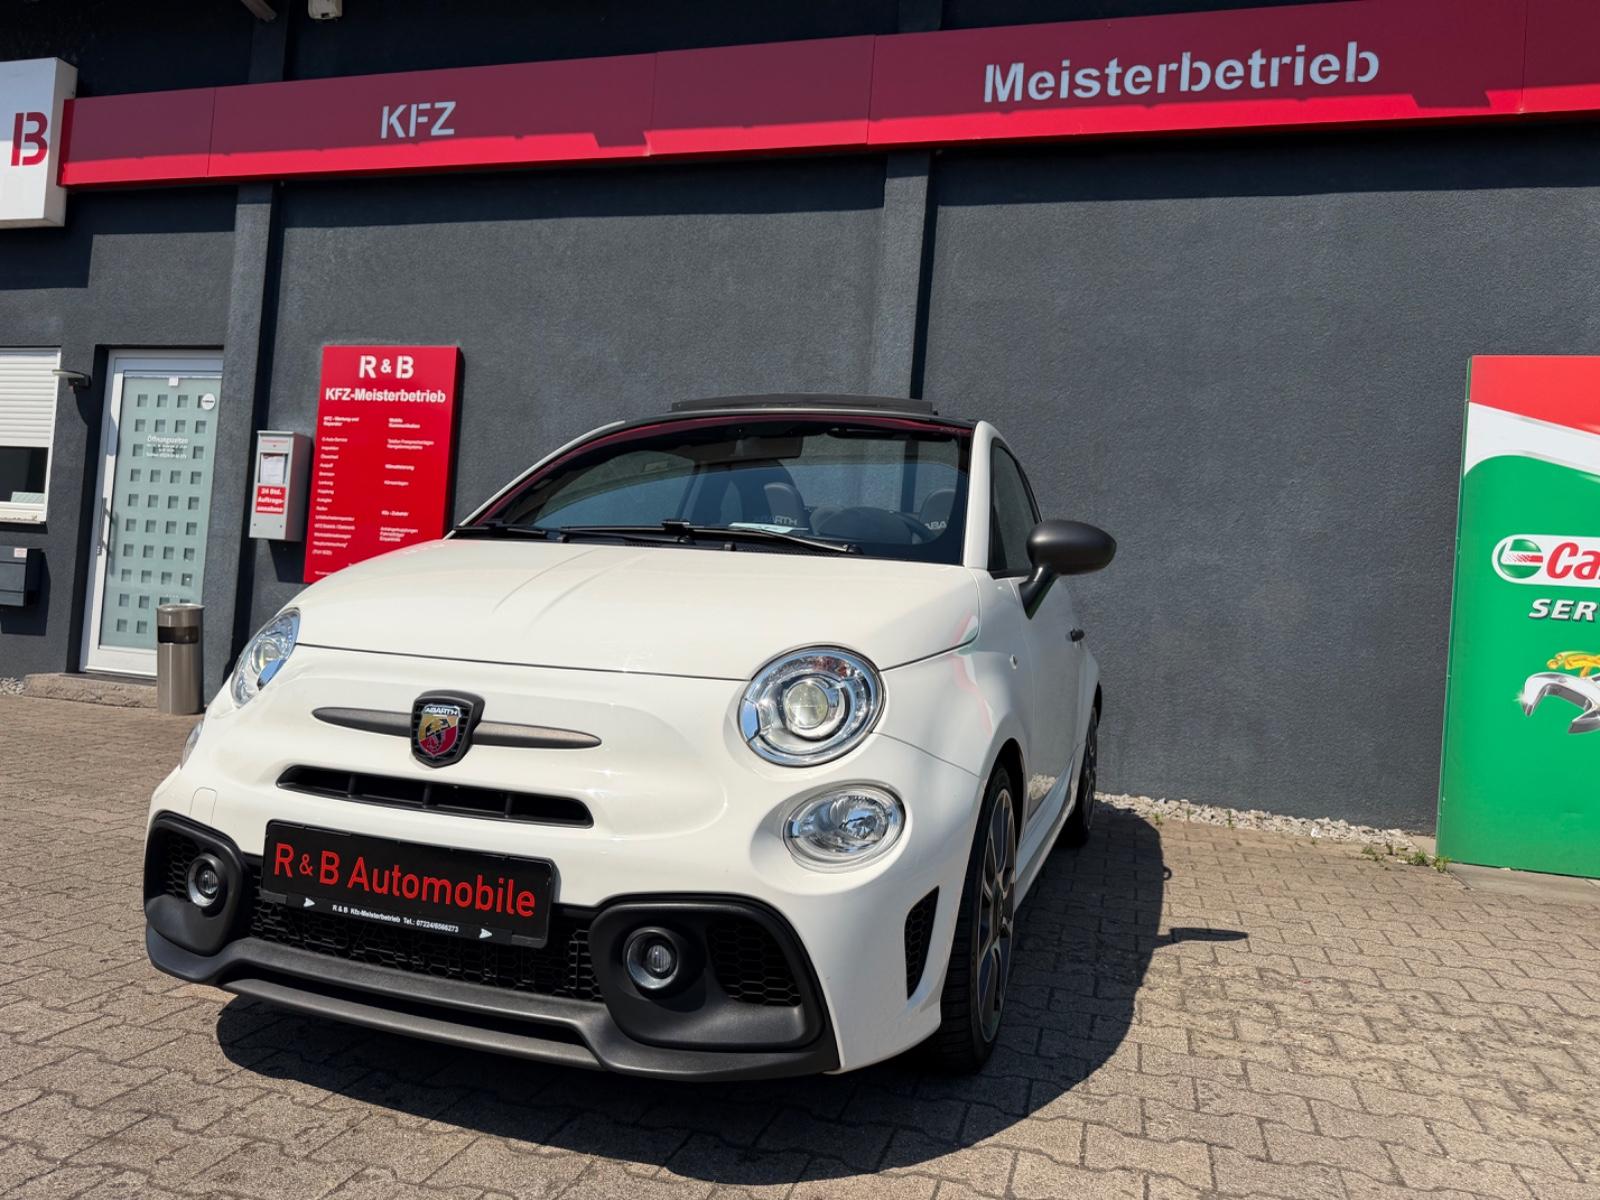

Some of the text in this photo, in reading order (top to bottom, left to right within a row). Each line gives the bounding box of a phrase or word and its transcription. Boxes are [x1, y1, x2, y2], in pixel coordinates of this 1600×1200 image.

[984, 41, 1380, 103] Meisterbetrieb
[380, 101, 456, 139] KFZ
[11, 112, 48, 167] B
[358, 355, 414, 379] R & B
[325, 387, 446, 403] KFZ-Meisterbetrieb
[1528, 598, 1597, 622] SER
[425, 707, 458, 715] ABARTH
[273, 842, 536, 917] R & B Automobile
